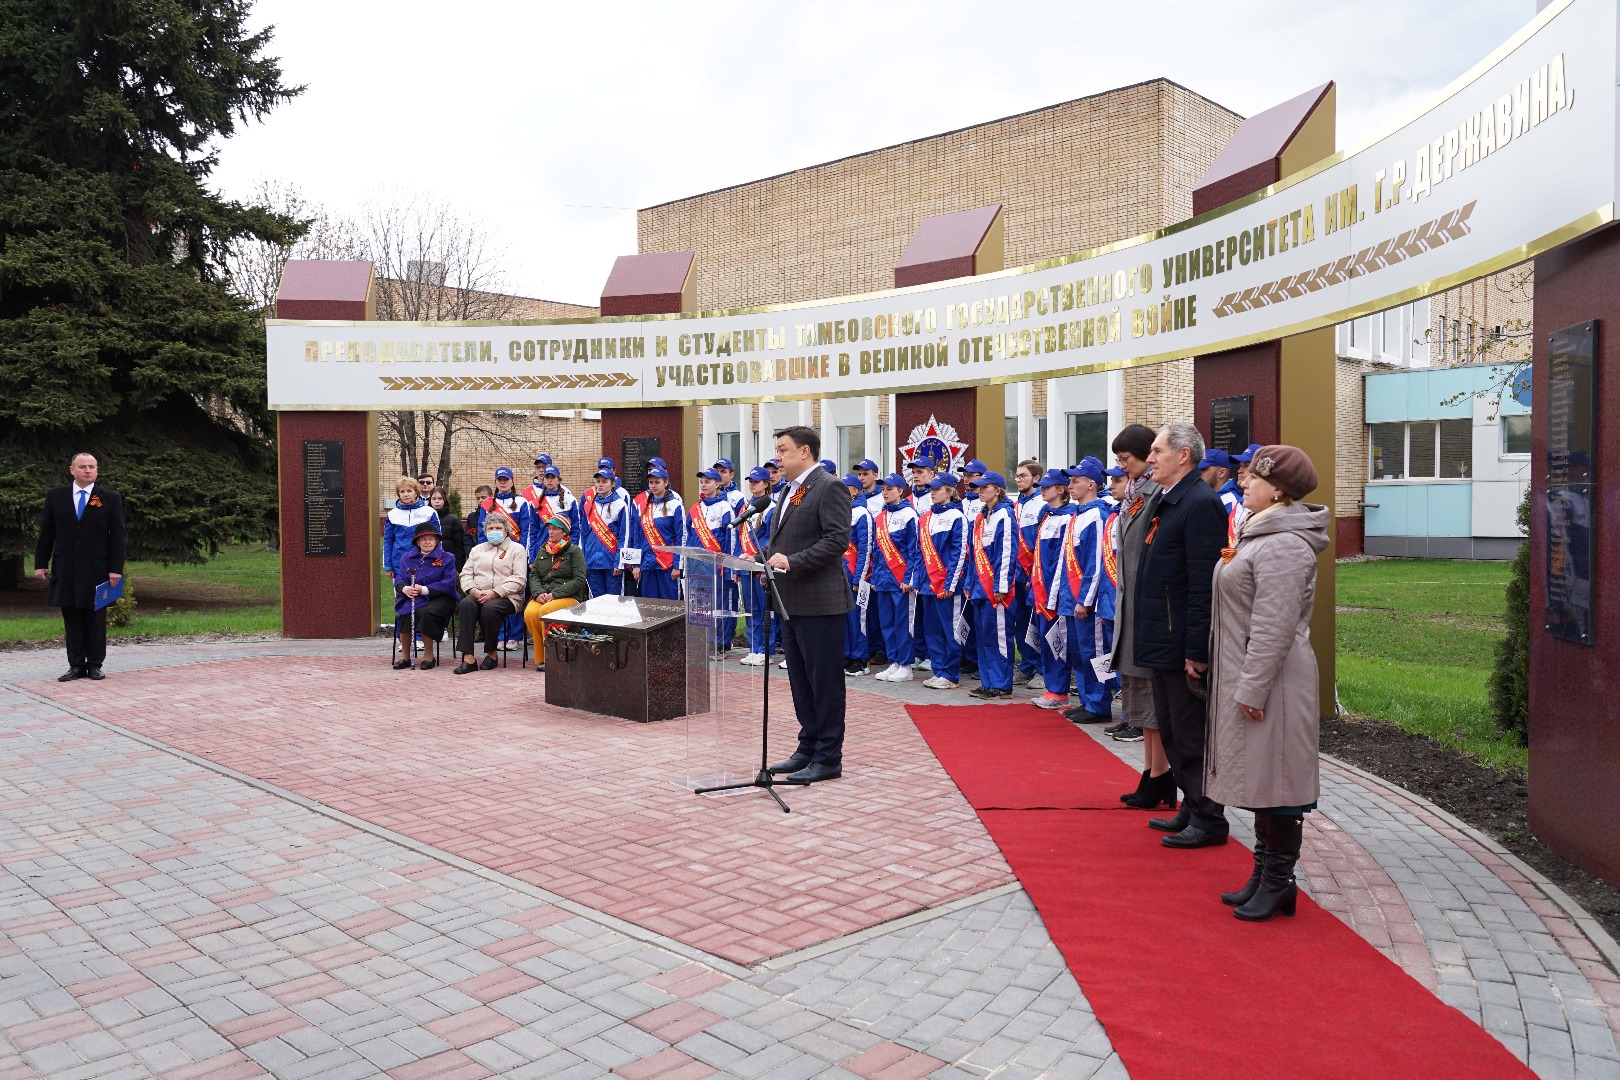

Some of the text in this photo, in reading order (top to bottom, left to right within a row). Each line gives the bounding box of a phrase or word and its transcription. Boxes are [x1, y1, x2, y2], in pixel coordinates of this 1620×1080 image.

[304, 340, 498, 366] ПРЕПОДАВАТЕЛИ,
[508, 336, 645, 364] СОТРУДНИКИ
[655, 335, 668, 357] И
[678, 326, 786, 357] СТУДЕНТЫ
[794, 307, 937, 348] ТАМБОВСКОГО
[946, 263, 1153, 330] ГОСУДАРСТВЕННОГО
[1162, 204, 1315, 289] УНИВЕРСИТЕТА
[1324, 183, 1365, 236] ИМ.
[655, 294, 1197, 388] УЧАСТВОВАВШИЕ В ВЕЛИКОЙ ОТЕЧЕСТВЕННОЙ ВОЙНЕ
